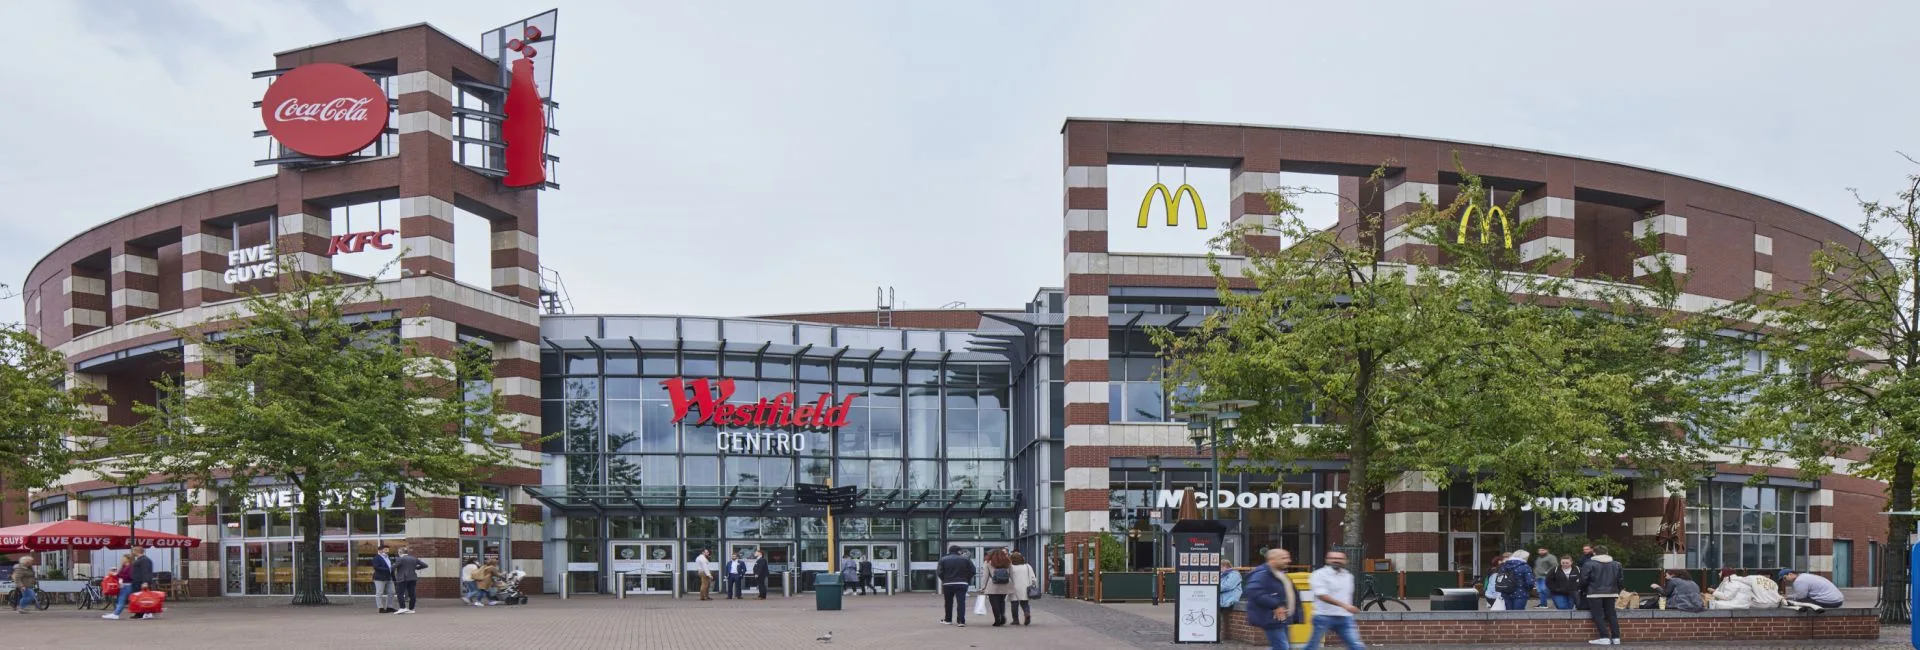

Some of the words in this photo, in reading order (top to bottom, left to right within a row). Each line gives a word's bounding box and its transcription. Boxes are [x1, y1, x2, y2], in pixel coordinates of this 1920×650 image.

[274, 97, 374, 122] Coca-Cola
[1137, 184, 1208, 230] M
[326, 229, 395, 256] KFC
[228, 244, 274, 266] FIVE
[224, 262, 278, 284] GUYS
[659, 376, 861, 428] Westfield
[717, 431, 805, 452] CENTRO
[465, 495, 504, 511] FIVE
[1156, 490, 1347, 509] McDonald's
[461, 511, 508, 526] GUYS
[3, 536, 24, 545] GUYS
[37, 536, 70, 545] FIVE
[72, 536, 111, 545] GUYS
[124, 538, 155, 546] FIVE
[156, 539, 192, 547] GUYS
